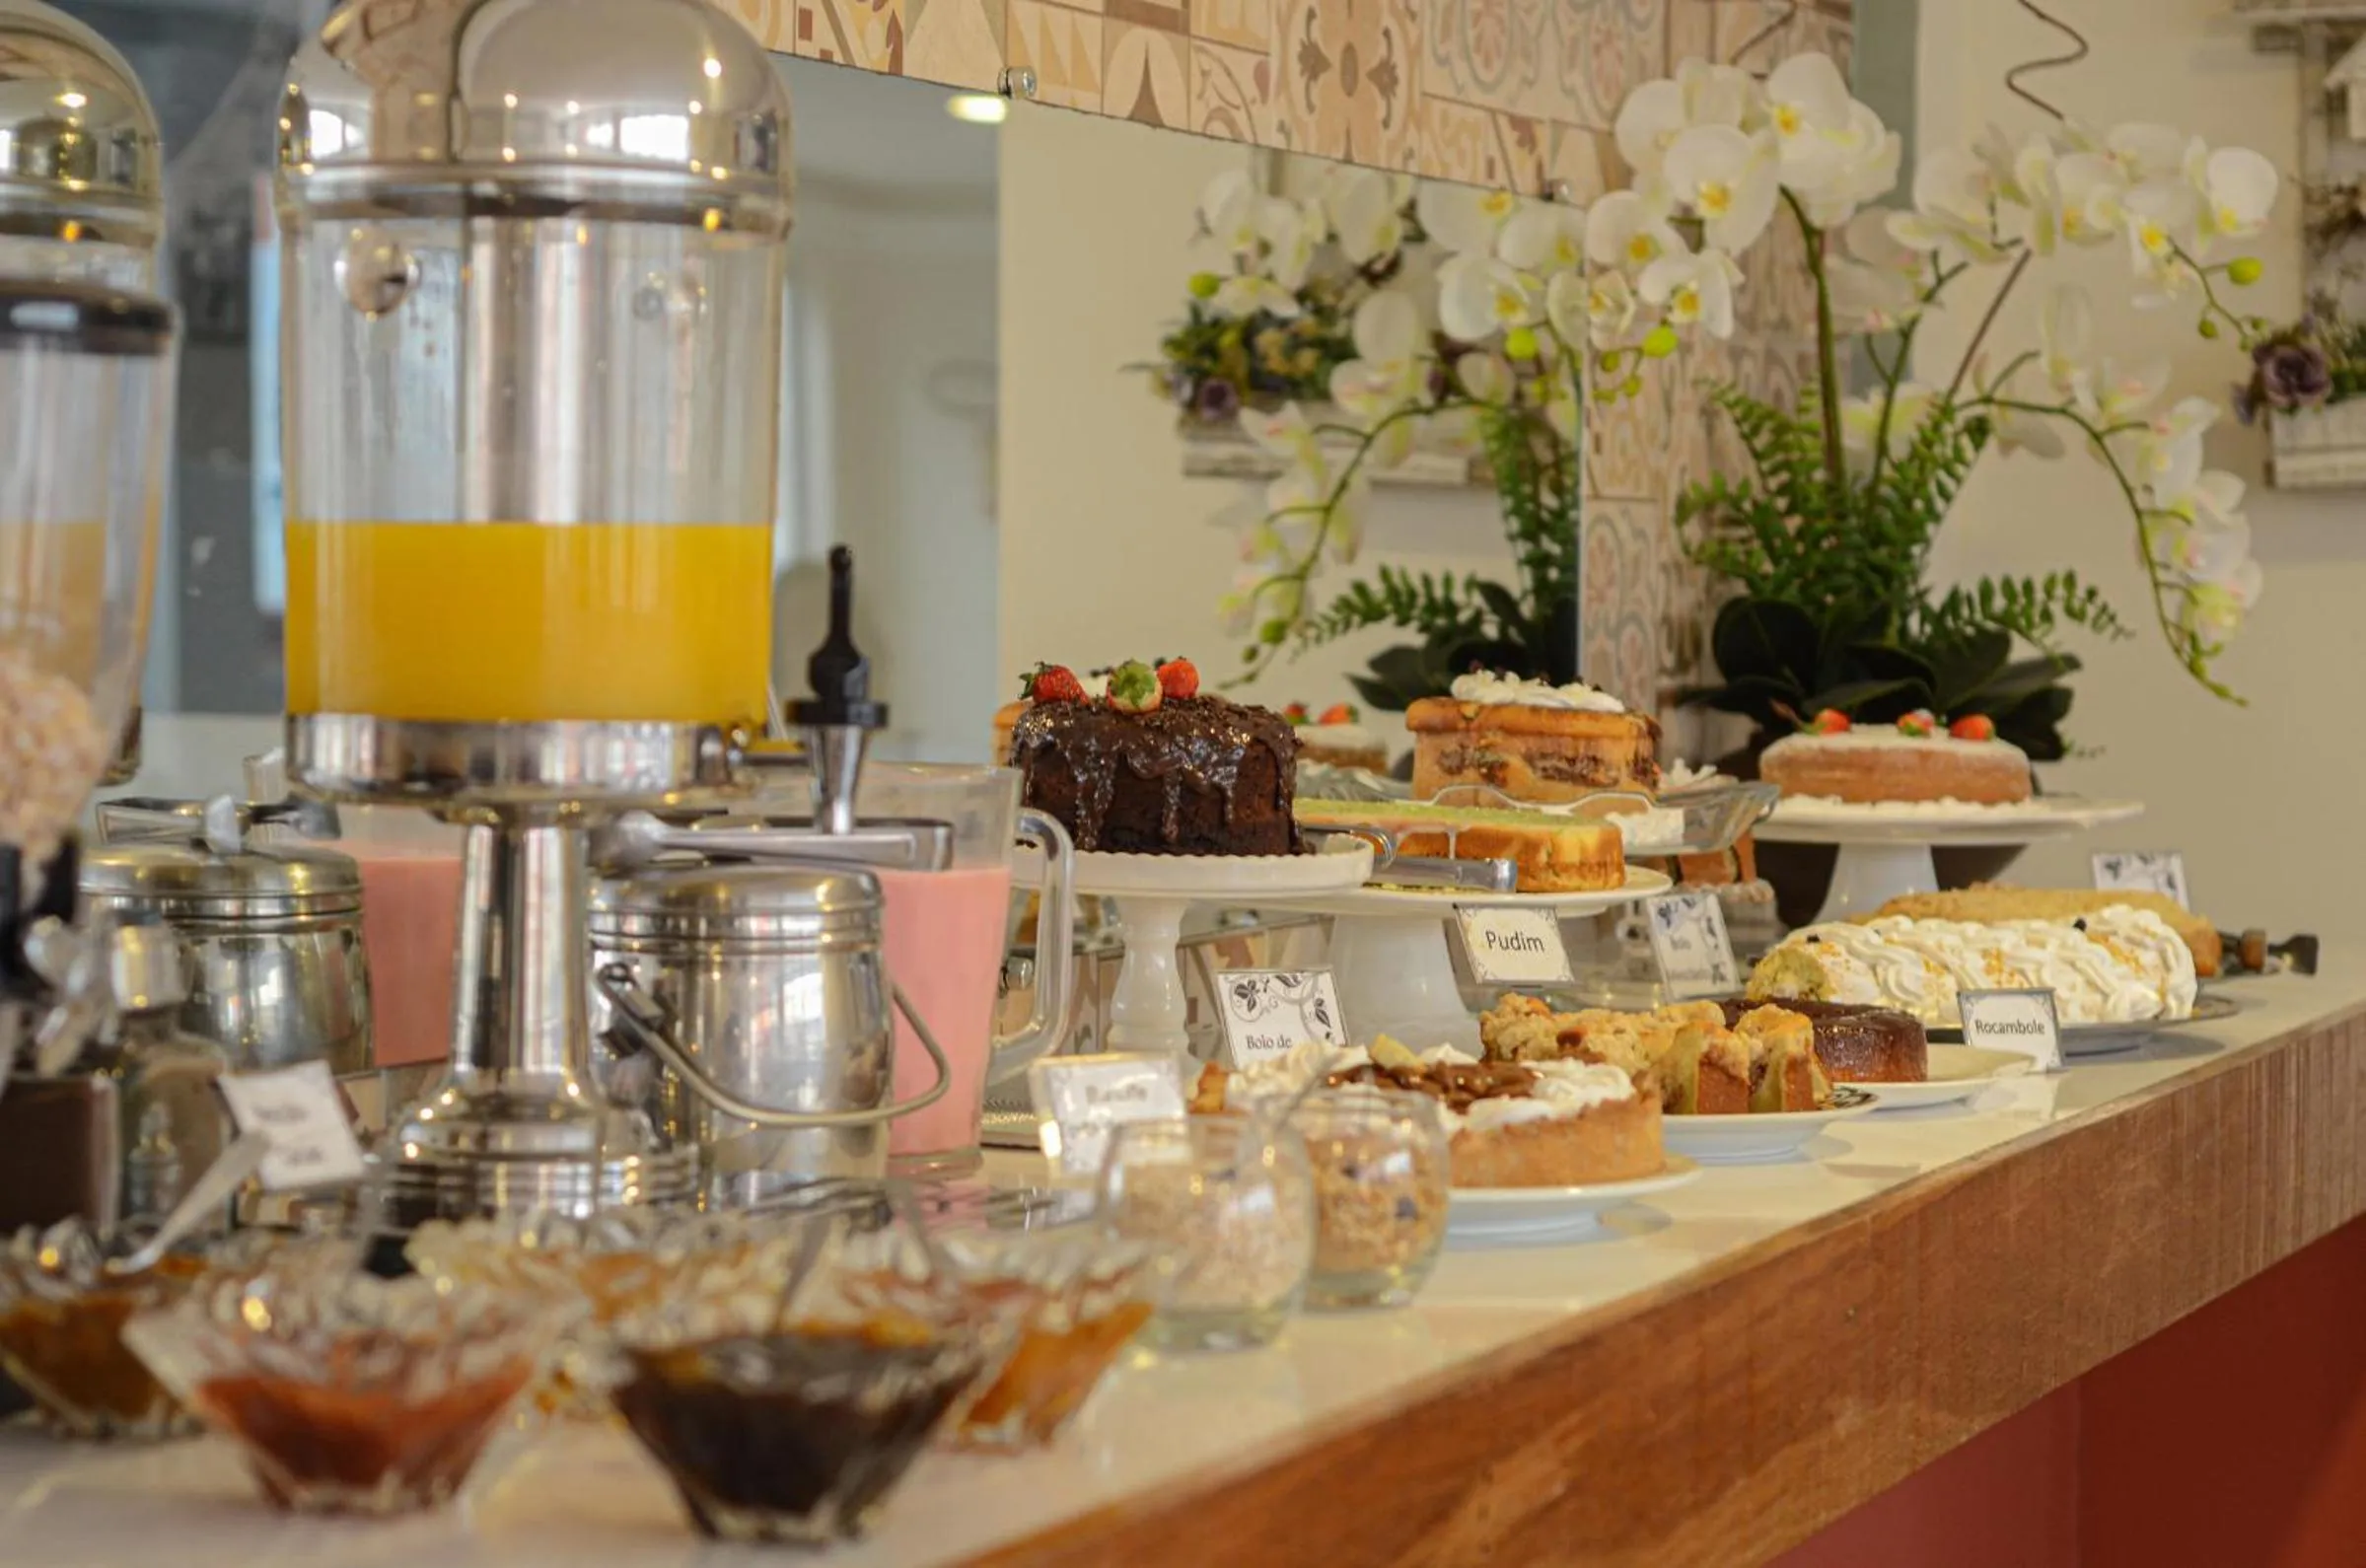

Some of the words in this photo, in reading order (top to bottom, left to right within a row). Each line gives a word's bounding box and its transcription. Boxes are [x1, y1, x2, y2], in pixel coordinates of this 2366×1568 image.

[1485, 929, 1544, 953] Pudim
[1974, 1018, 2044, 1034] Rocambole
[1246, 1033, 1273, 1049] Bolo
[1277, 1033, 1292, 1048] de
